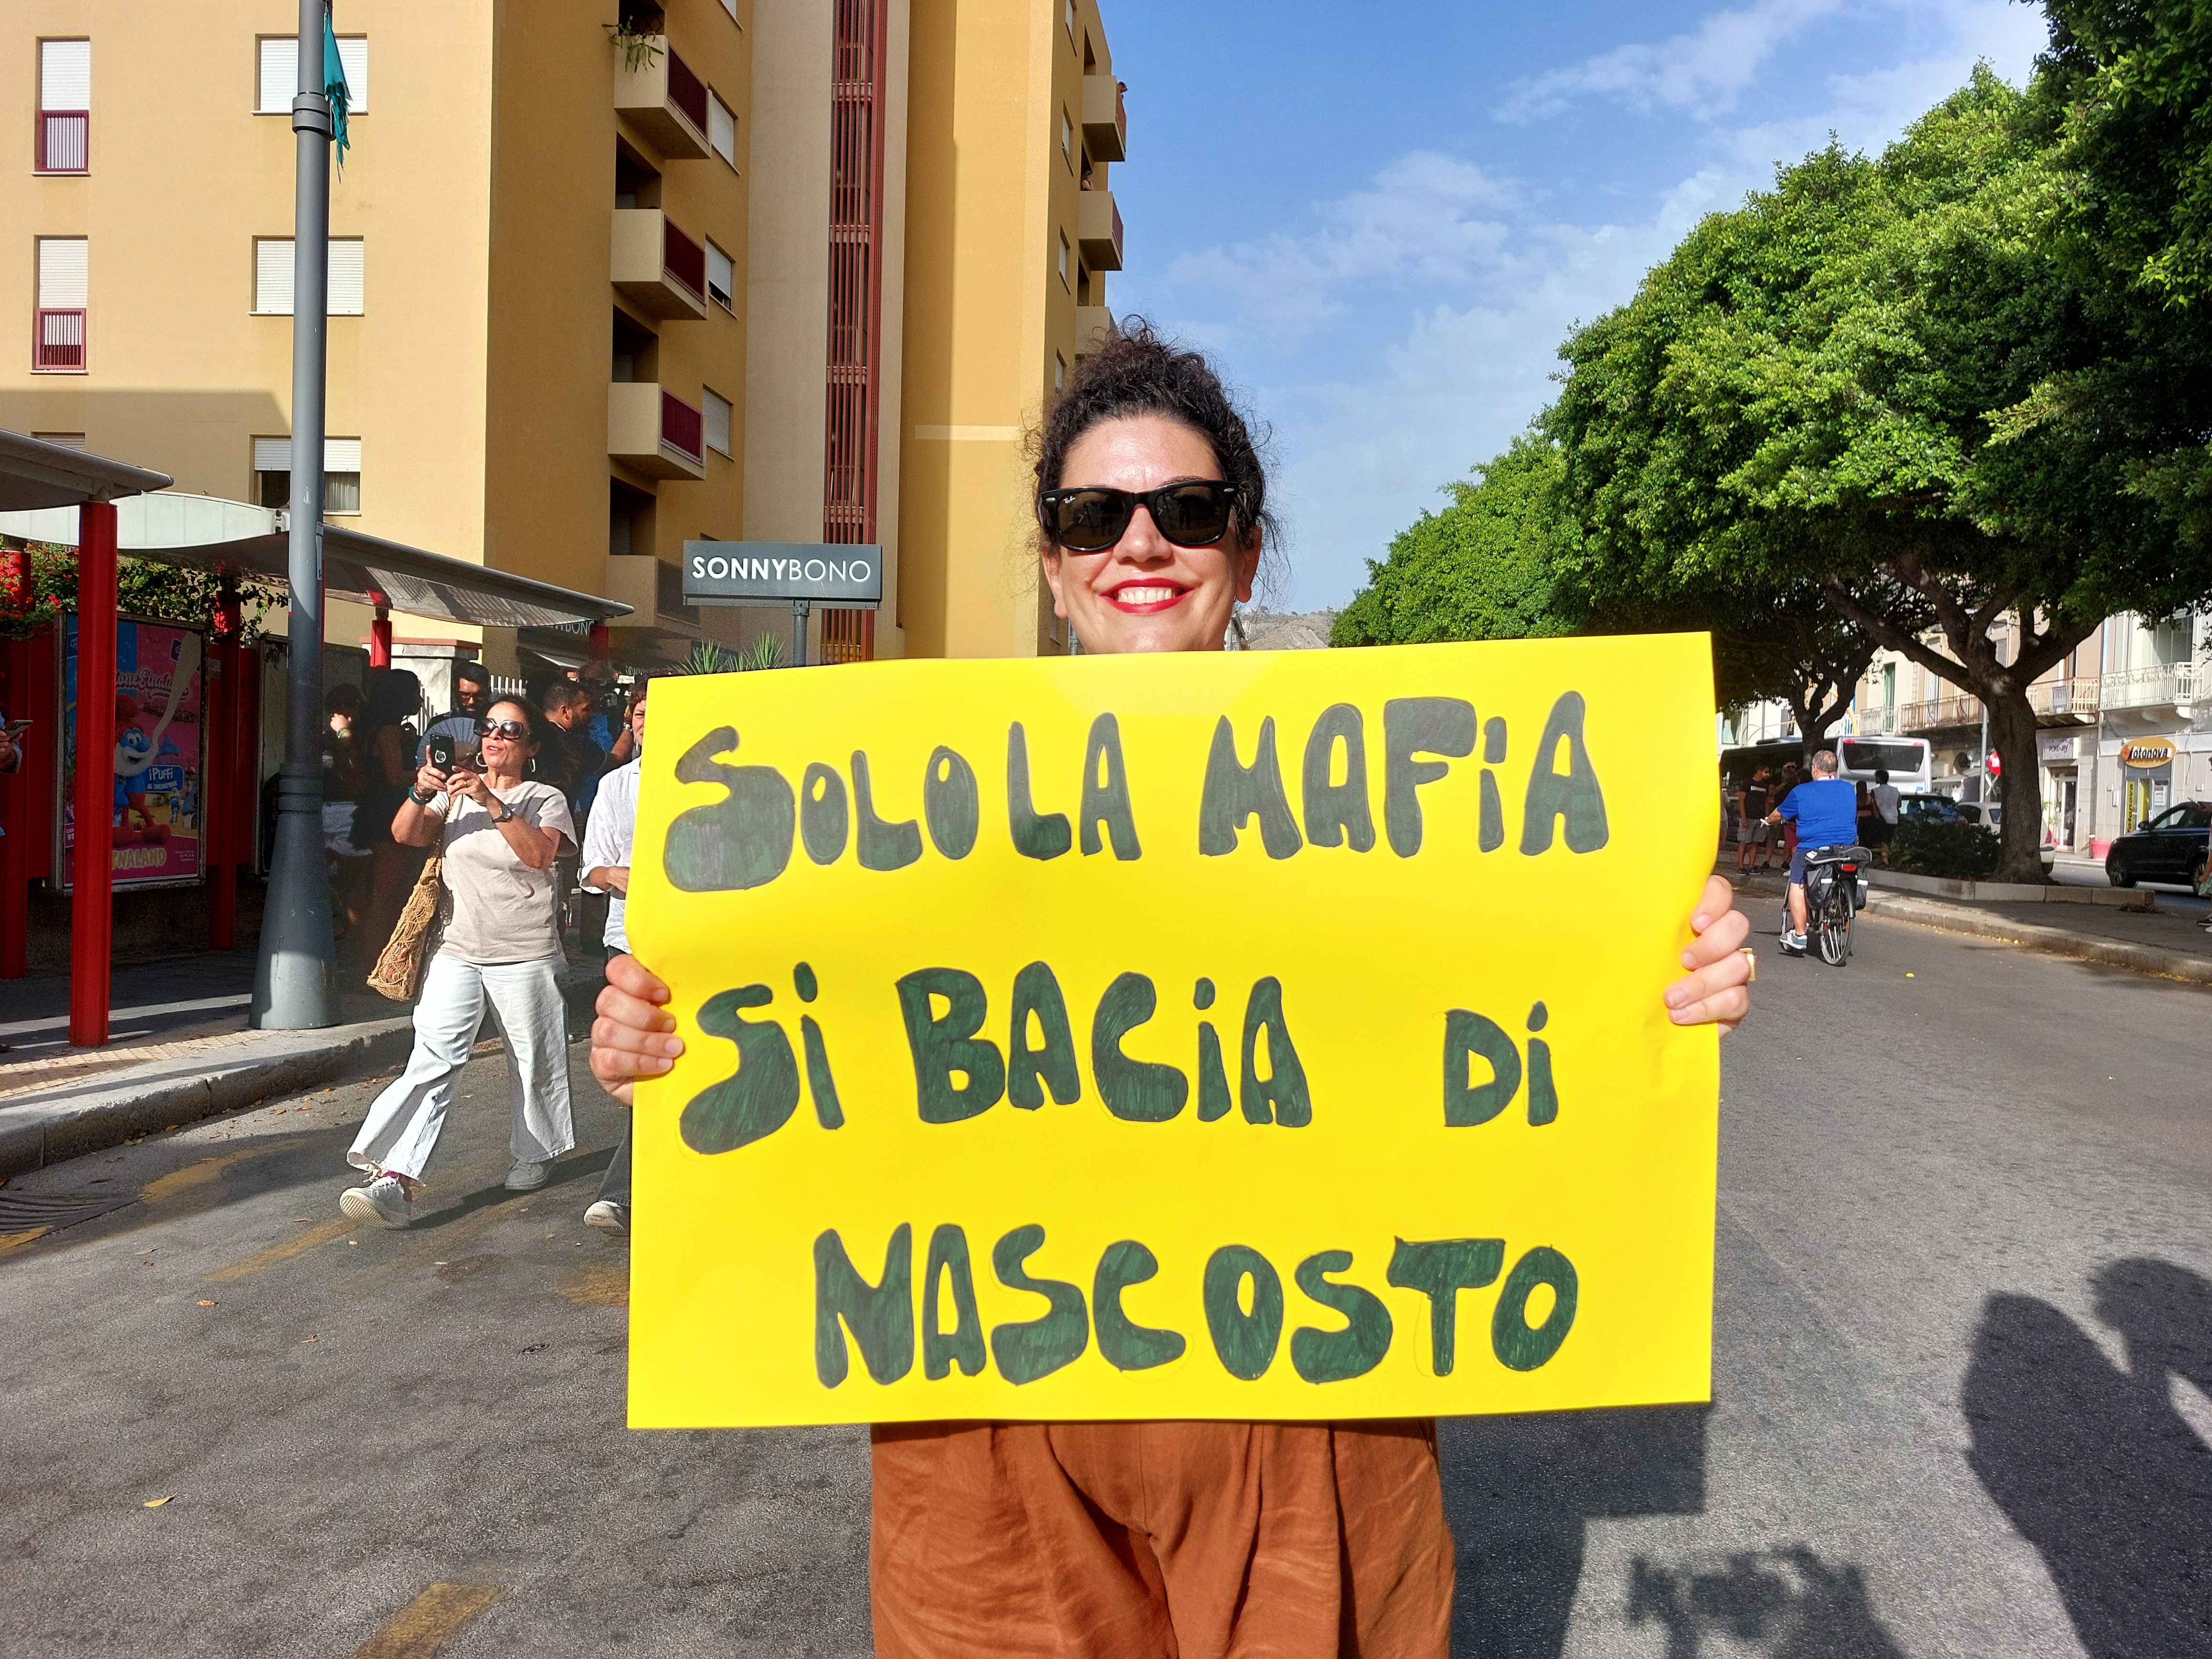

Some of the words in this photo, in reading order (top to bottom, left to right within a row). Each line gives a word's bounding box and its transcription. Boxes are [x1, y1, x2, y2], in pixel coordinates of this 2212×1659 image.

[692, 556, 871, 582] SONNYBONO
[2129, 746, 2170, 760] fotonova
[1009, 714, 1142, 862] LA
[112, 848, 167, 871] TNALAND
[814, 1223, 1578, 1388] NASCOSTO
